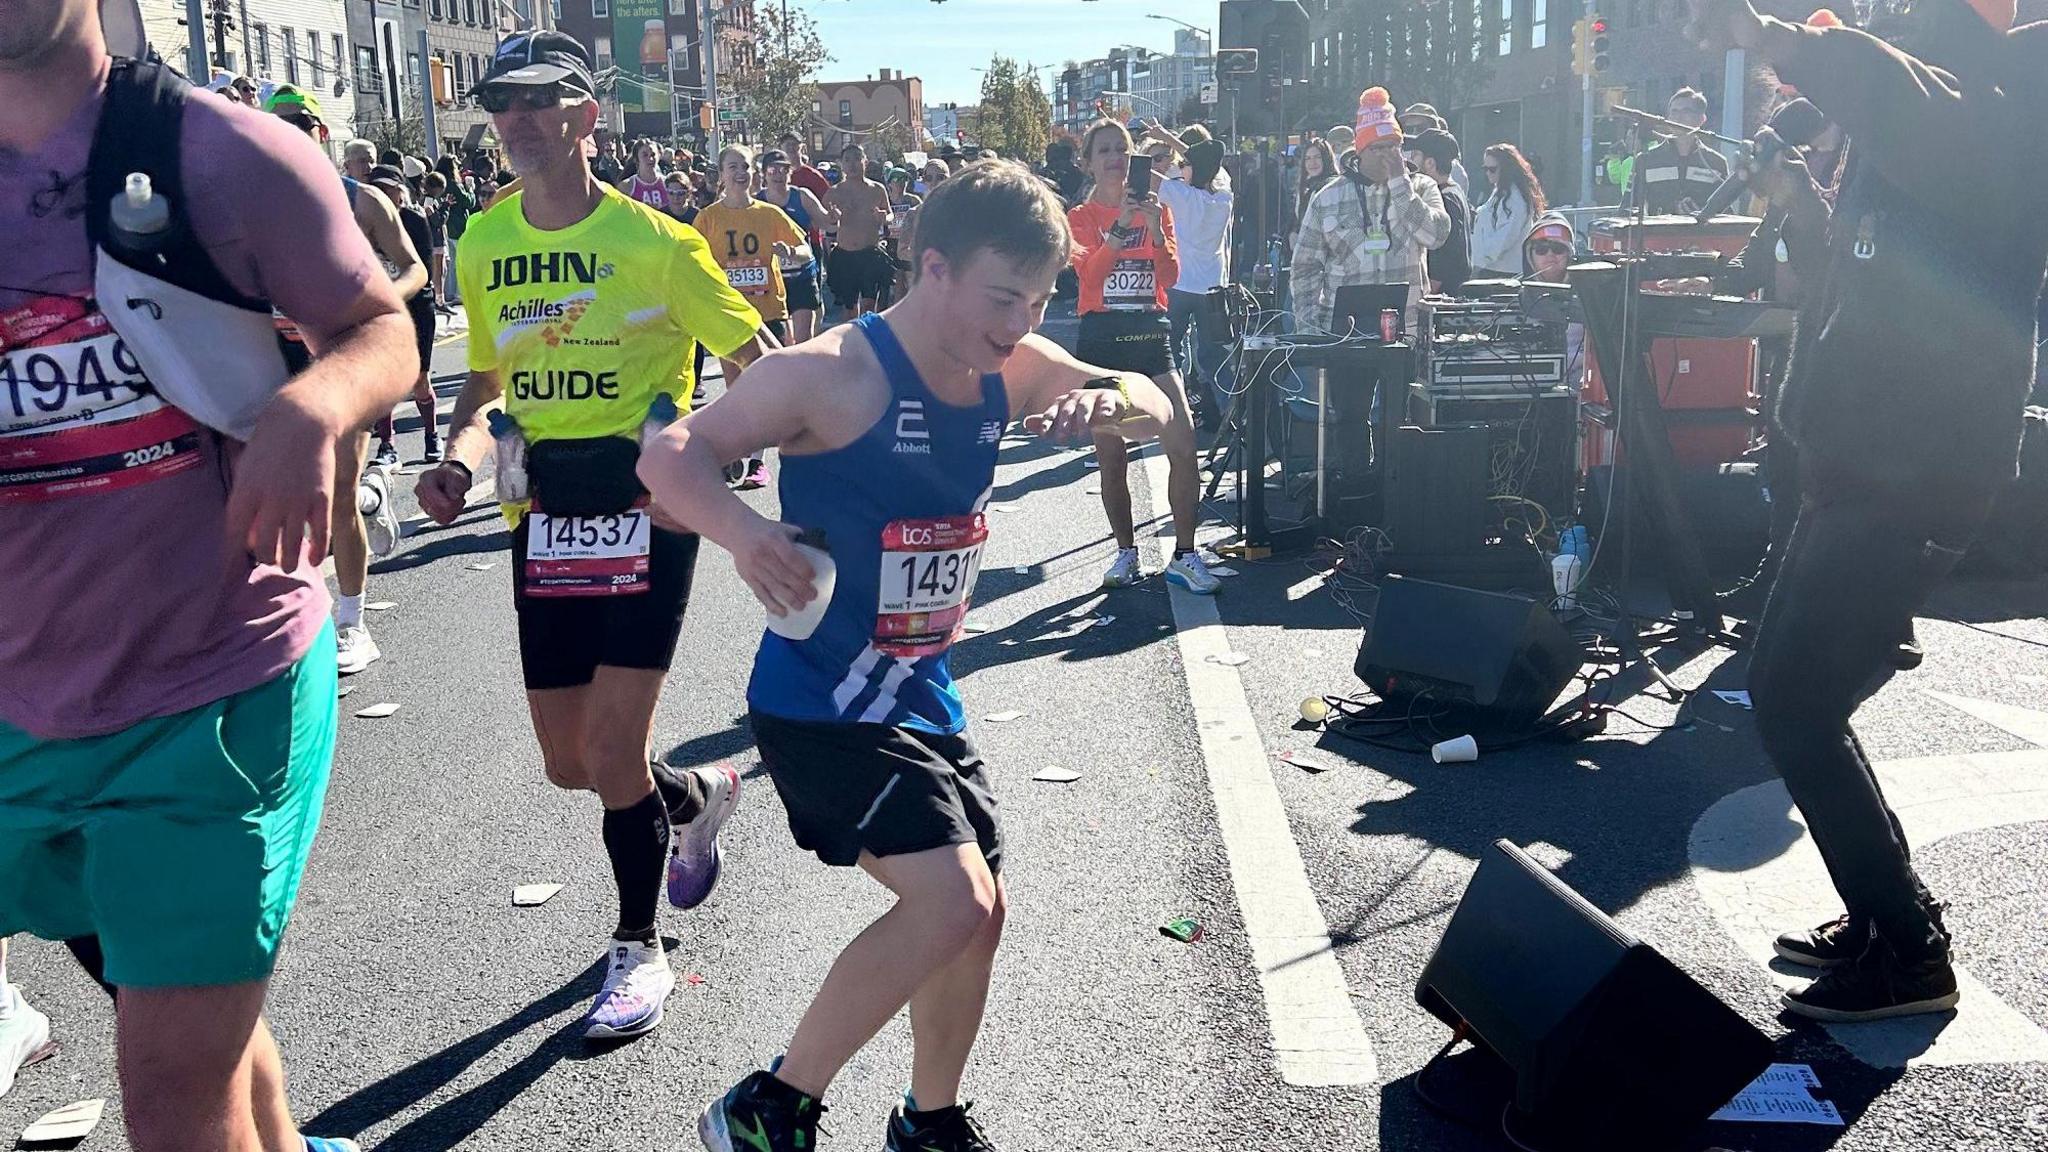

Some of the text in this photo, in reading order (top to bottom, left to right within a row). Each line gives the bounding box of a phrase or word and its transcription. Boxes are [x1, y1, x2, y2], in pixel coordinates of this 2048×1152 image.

[616, 6, 631, 17] the
[486, 252, 597, 292] JOHN
[1107, 273, 1154, 290] 30222
[498, 298, 564, 322] Achilles
[563, 337, 621, 346] New Zealand
[512, 370, 619, 401] GUIDE
[124, 441, 175, 468] 2024
[892, 441, 931, 454] Abbott
[541, 512, 641, 548] 14537
[902, 524, 932, 546] tcs
[551, 550, 556, 558] 1
[612, 574, 637, 585] 2024
[884, 602, 904, 610] WAVE
[905, 601, 911, 610] 1
